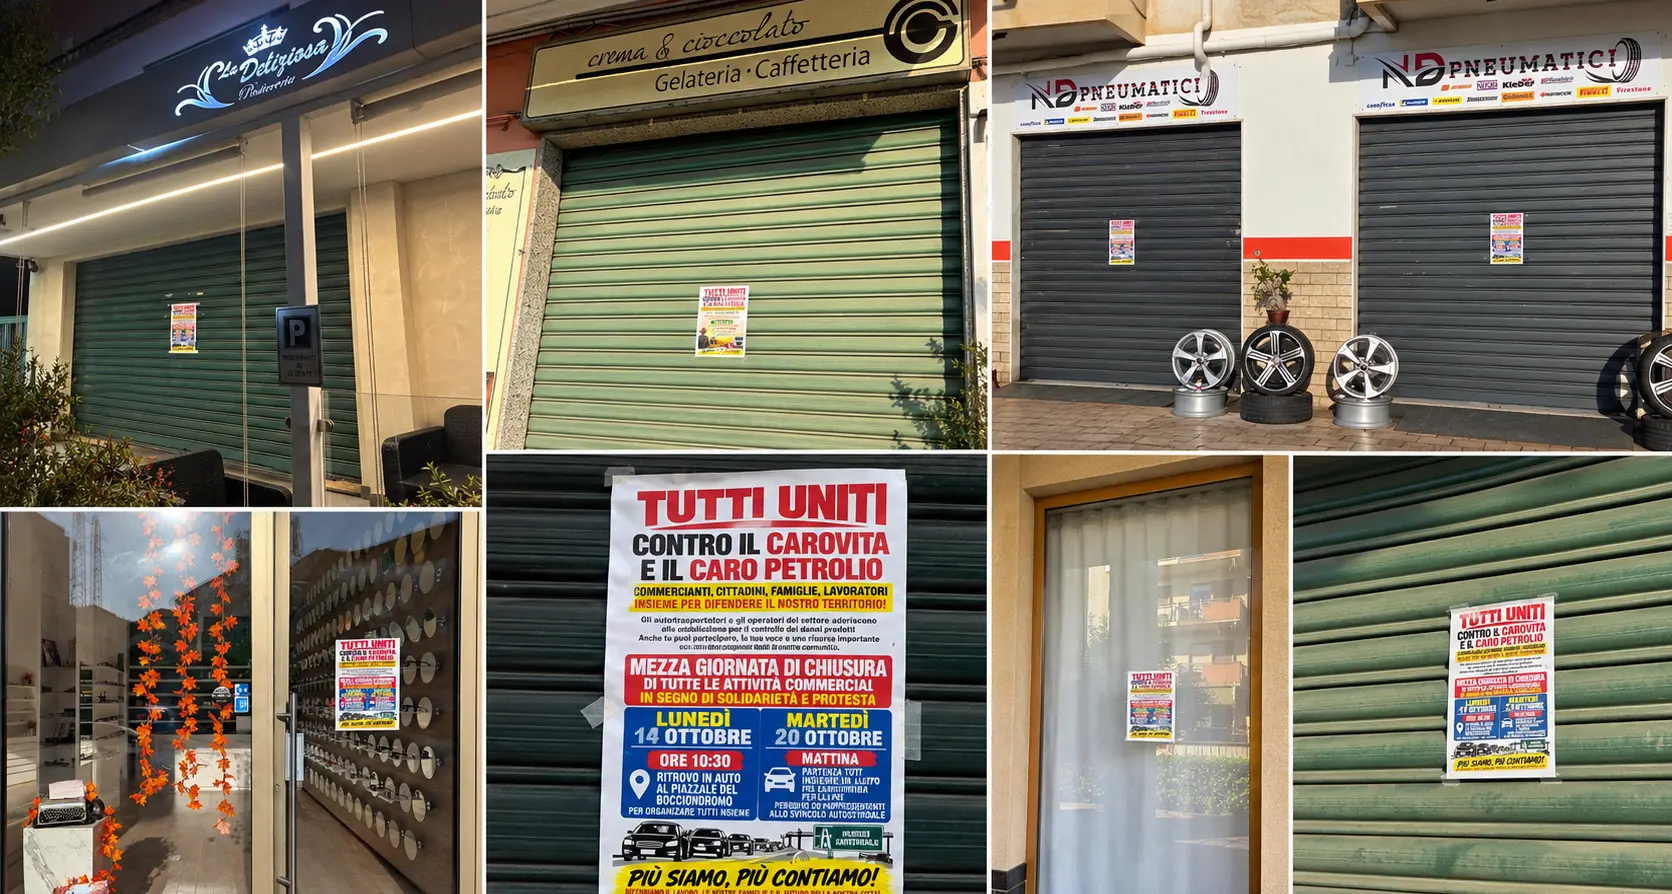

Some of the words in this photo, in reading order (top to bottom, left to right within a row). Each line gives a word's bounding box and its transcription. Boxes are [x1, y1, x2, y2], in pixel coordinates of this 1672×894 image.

[588, 48, 648, 68] crema
[655, 33, 675, 60] &
[682, 9, 810, 54] cioccolato
[218, 61, 239, 81] La
[655, 64, 741, 92] Gelateria
[755, 46, 870, 79] Caffetteria
[1373, 52, 1446, 89] ND
[1449, 48, 1617, 79] PNEUMATICI
[1025, 79, 1078, 110] ND
[1079, 77, 1201, 102] PNEUMATICI
[289, 319, 306, 347] P
[637, 487, 764, 527] TUTTI
[778, 483, 888, 526] UNITI
[632, 533, 732, 556] CONTRO
[739, 532, 760, 555] IL
[766, 531, 890, 555] CAROVITA
[640, 560, 655, 580] E
[662, 559, 683, 581] IL
[689, 559, 758, 580] CARO
[765, 557, 883, 580] PETROLIO
[634, 586, 714, 597] COMMERCIANTI,
[716, 586, 768, 597] CITTADINI,
[771, 586, 821, 597] FAMIGLIE,
[823, 586, 888, 596] LAVORATORI
[634, 599, 678, 609] INSIEME
[681, 599, 701, 609] PER
[704, 599, 763, 609] DIFENDERE
[766, 599, 775, 609] IL
[778, 599, 819, 609] NOSTRO
[823, 599, 887, 609] TERRITORIO!
[1460, 608, 1502, 629] TUTTI
[1506, 603, 1545, 621] UNITI
[1457, 628, 1491, 641] CONTRO
[1502, 622, 1546, 636] CAROVITA
[1501, 633, 1543, 645] PETROLIO
[630, 658, 689, 676] MEZZA
[695, 658, 779, 677] GIORNATA
[784, 659, 800, 675] DI
[806, 659, 887, 677] CHIUSURA
[644, 678, 657, 690] DI
[660, 678, 701, 691] TUTTE
[705, 678, 719, 690] LE
[724, 677, 780, 691] ATTIVITÀ
[640, 692, 653, 703] IN
[657, 692, 698, 704] SEGNO
[702, 692, 714, 704] DI
[801, 693, 809, 705] E
[813, 693, 876, 706] PROTESTA
[656, 709, 731, 727] LUNEDÌ
[787, 711, 869, 729] MARTEDÌ
[634, 728, 659, 744] 14
[665, 729, 752, 745] OTTOBRE
[775, 729, 800, 745] 20
[805, 730, 883, 746] OTTOBRE
[660, 753, 688, 767] ORE
[692, 754, 731, 768] 10:30
[802, 753, 859, 765] MATTINA
[657, 772, 699, 783] RITROVO
[702, 773, 712, 782] IN
[715, 773, 741, 783] AUTO
[656, 784, 668, 794] AL
[671, 784, 716, 794] PIAZZALE
[720, 784, 738, 794] DEL
[769, 810, 788, 818] ALLO
[627, 865, 662, 887] PIÙ
[665, 869, 730, 888] SIAMO,
[736, 864, 769, 886] PIÙ
[771, 867, 880, 887] CONTIAMO!
